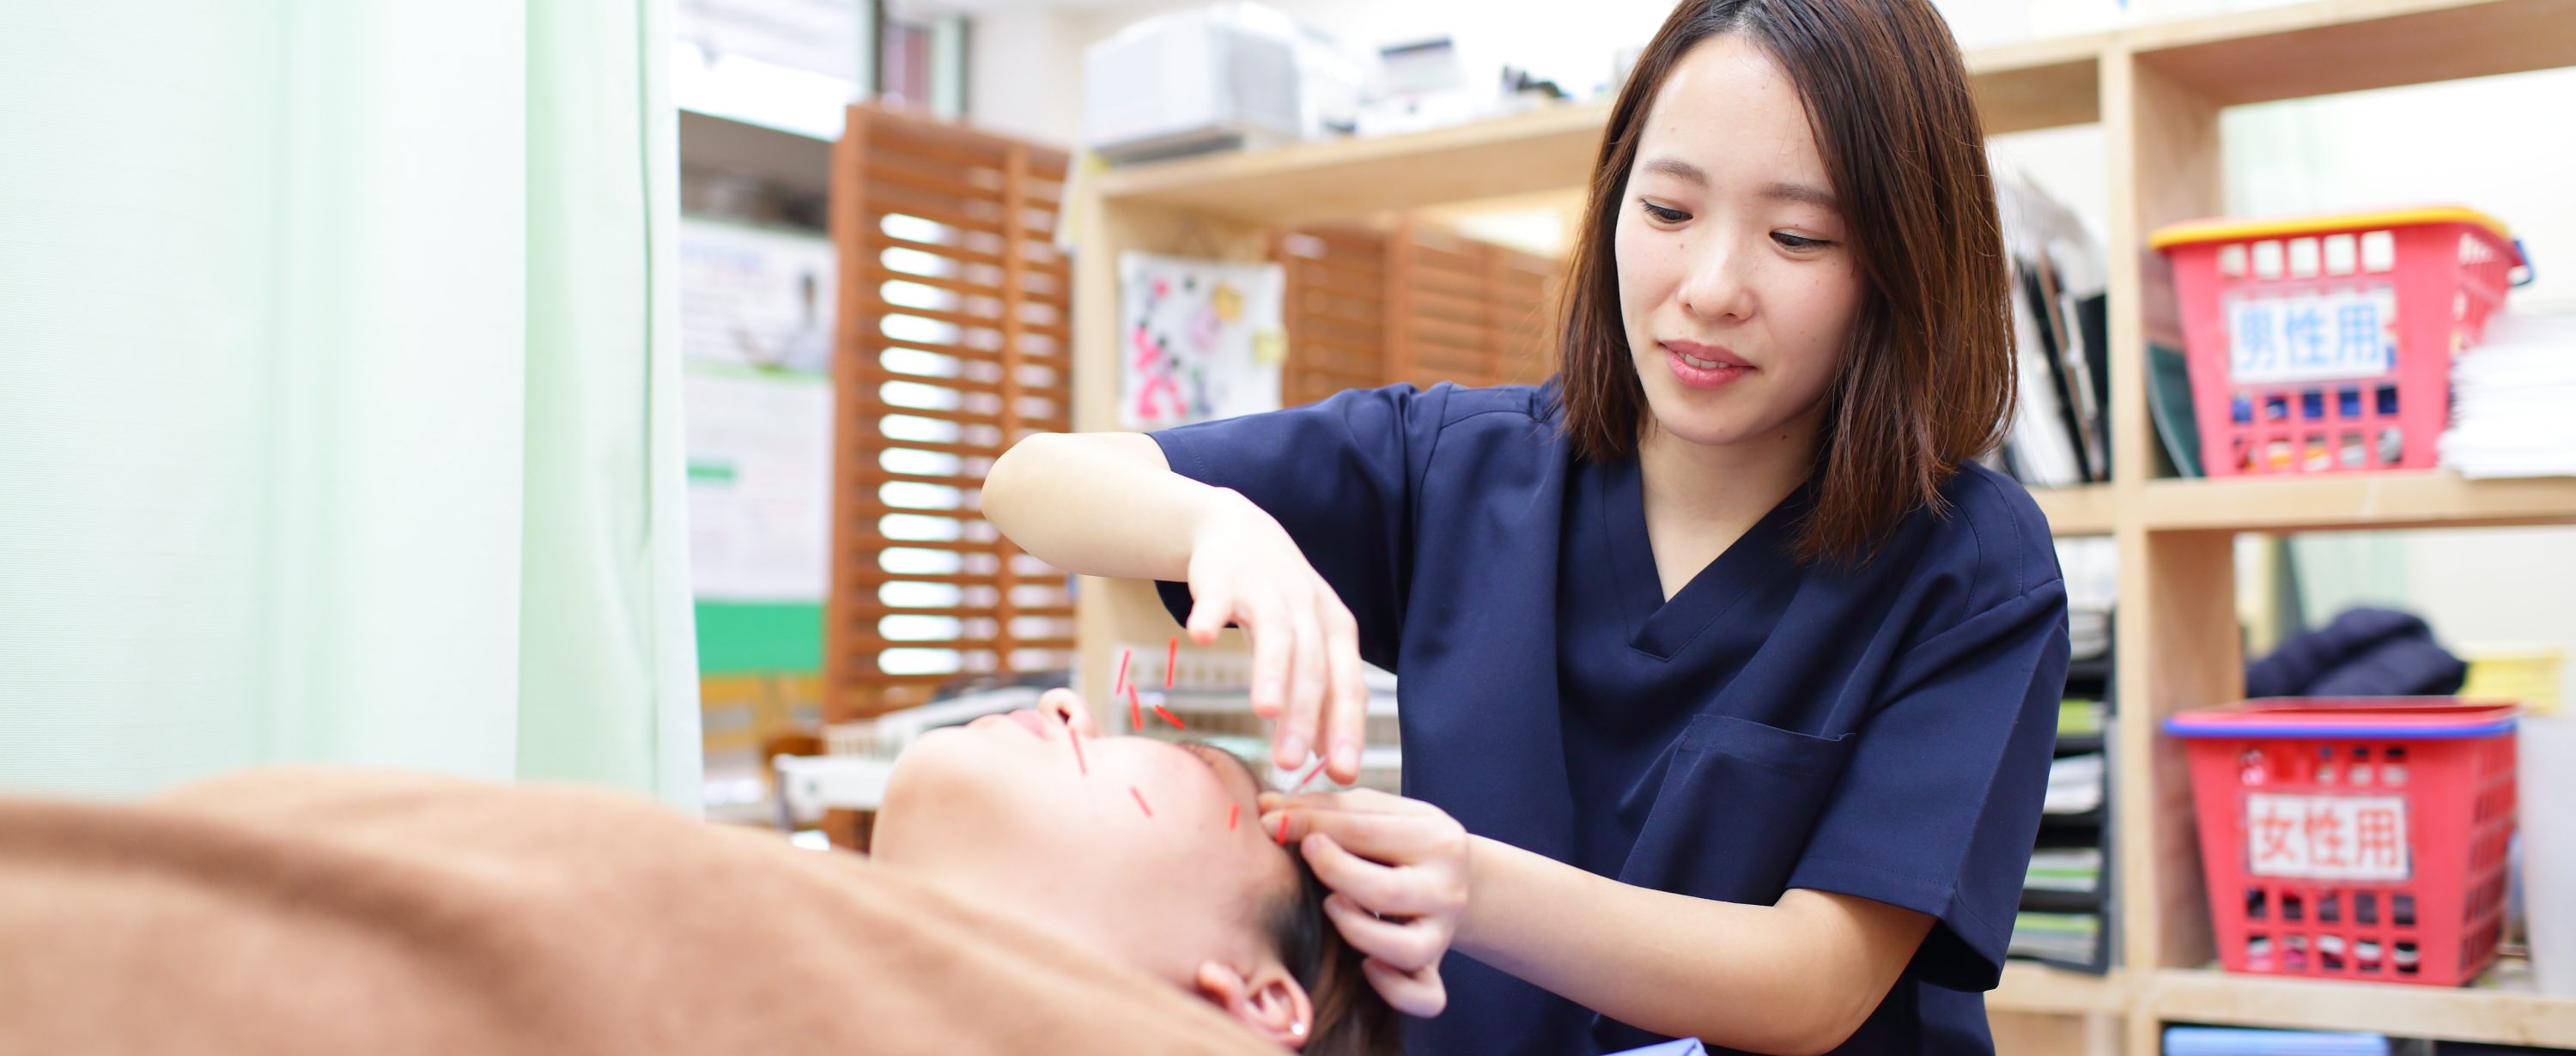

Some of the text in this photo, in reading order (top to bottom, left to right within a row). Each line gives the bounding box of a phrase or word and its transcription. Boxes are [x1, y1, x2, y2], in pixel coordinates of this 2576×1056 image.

[2240, 304, 2379, 369] 男性用
[2255, 806, 2397, 868] 女性用
